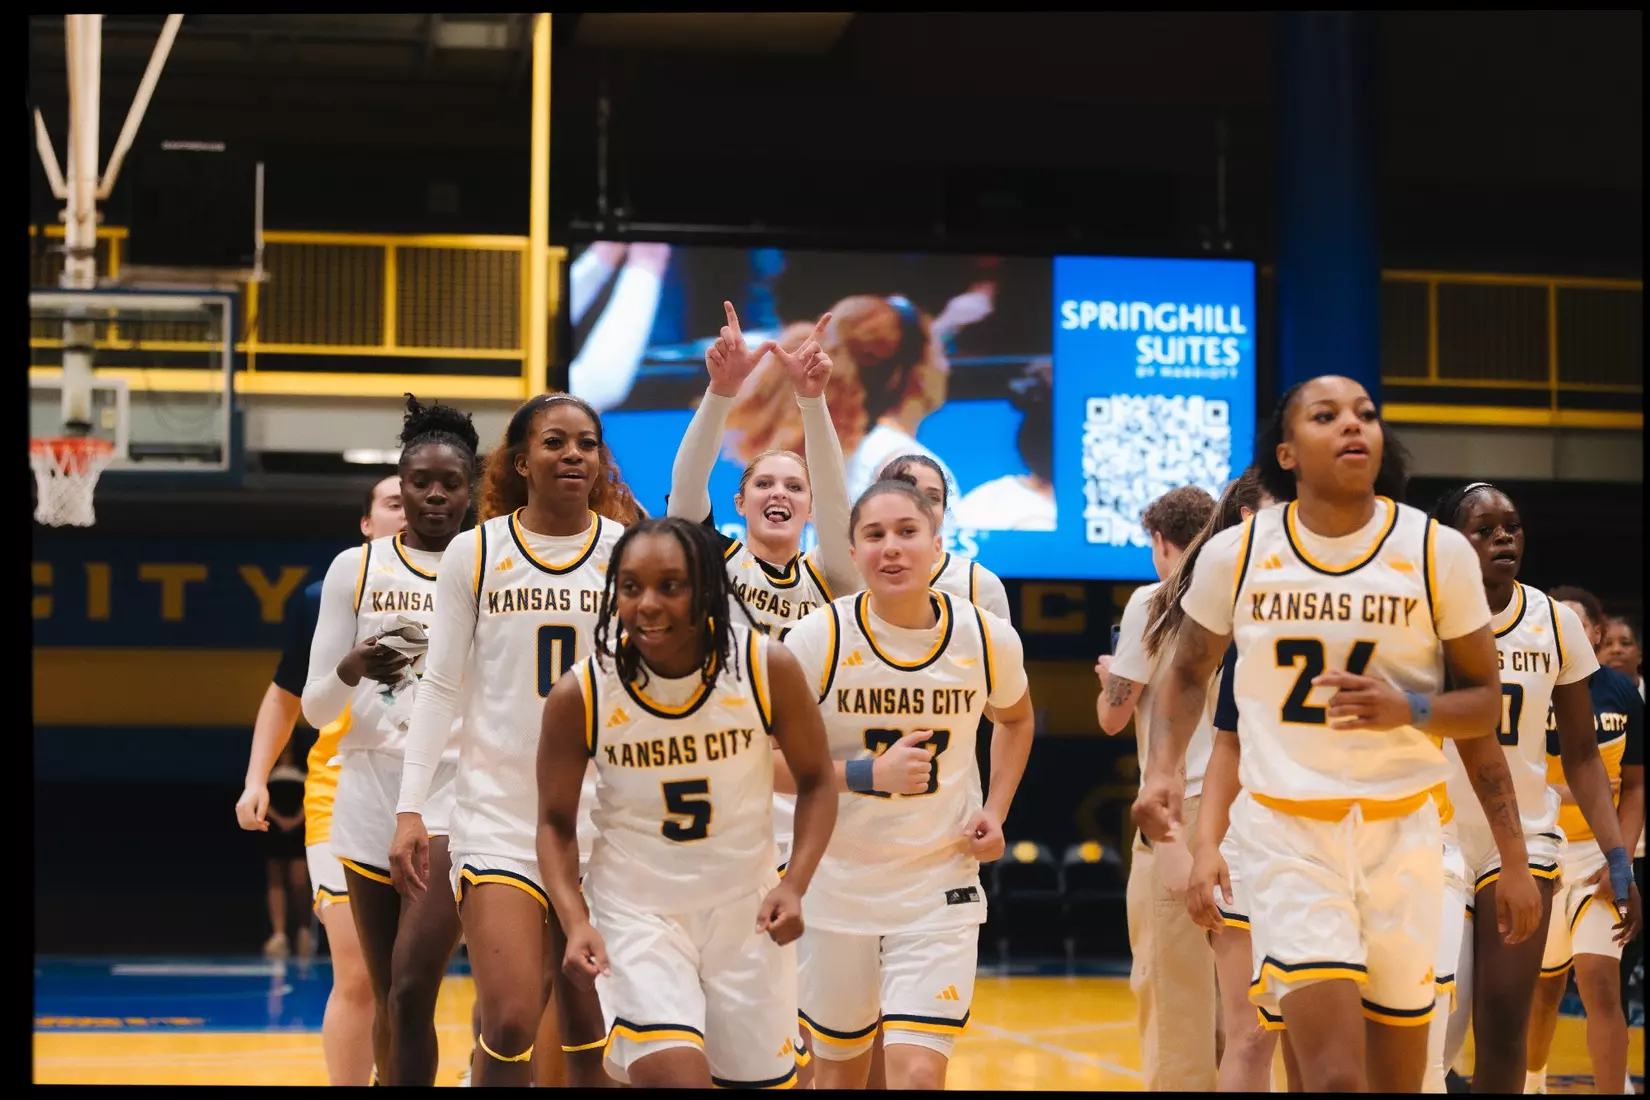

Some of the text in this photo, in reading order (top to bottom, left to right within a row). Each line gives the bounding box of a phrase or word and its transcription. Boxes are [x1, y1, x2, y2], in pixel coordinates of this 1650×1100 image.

[1061, 300, 1246, 334] SPRINGHILL
[1135, 335, 1240, 367] SUITES
[372, 591, 434, 612] KANSA
[488, 588, 571, 614] KANSAS
[1252, 592, 1418, 627] KANSAS CITY
[535, 624, 577, 698] 0
[1512, 651, 1551, 674] CITY
[837, 688, 977, 715] KANSAS CITY
[1495, 682, 1525, 747] 0
[604, 728, 755, 768] KANSAS CITY
[660, 776, 713, 843] 5
